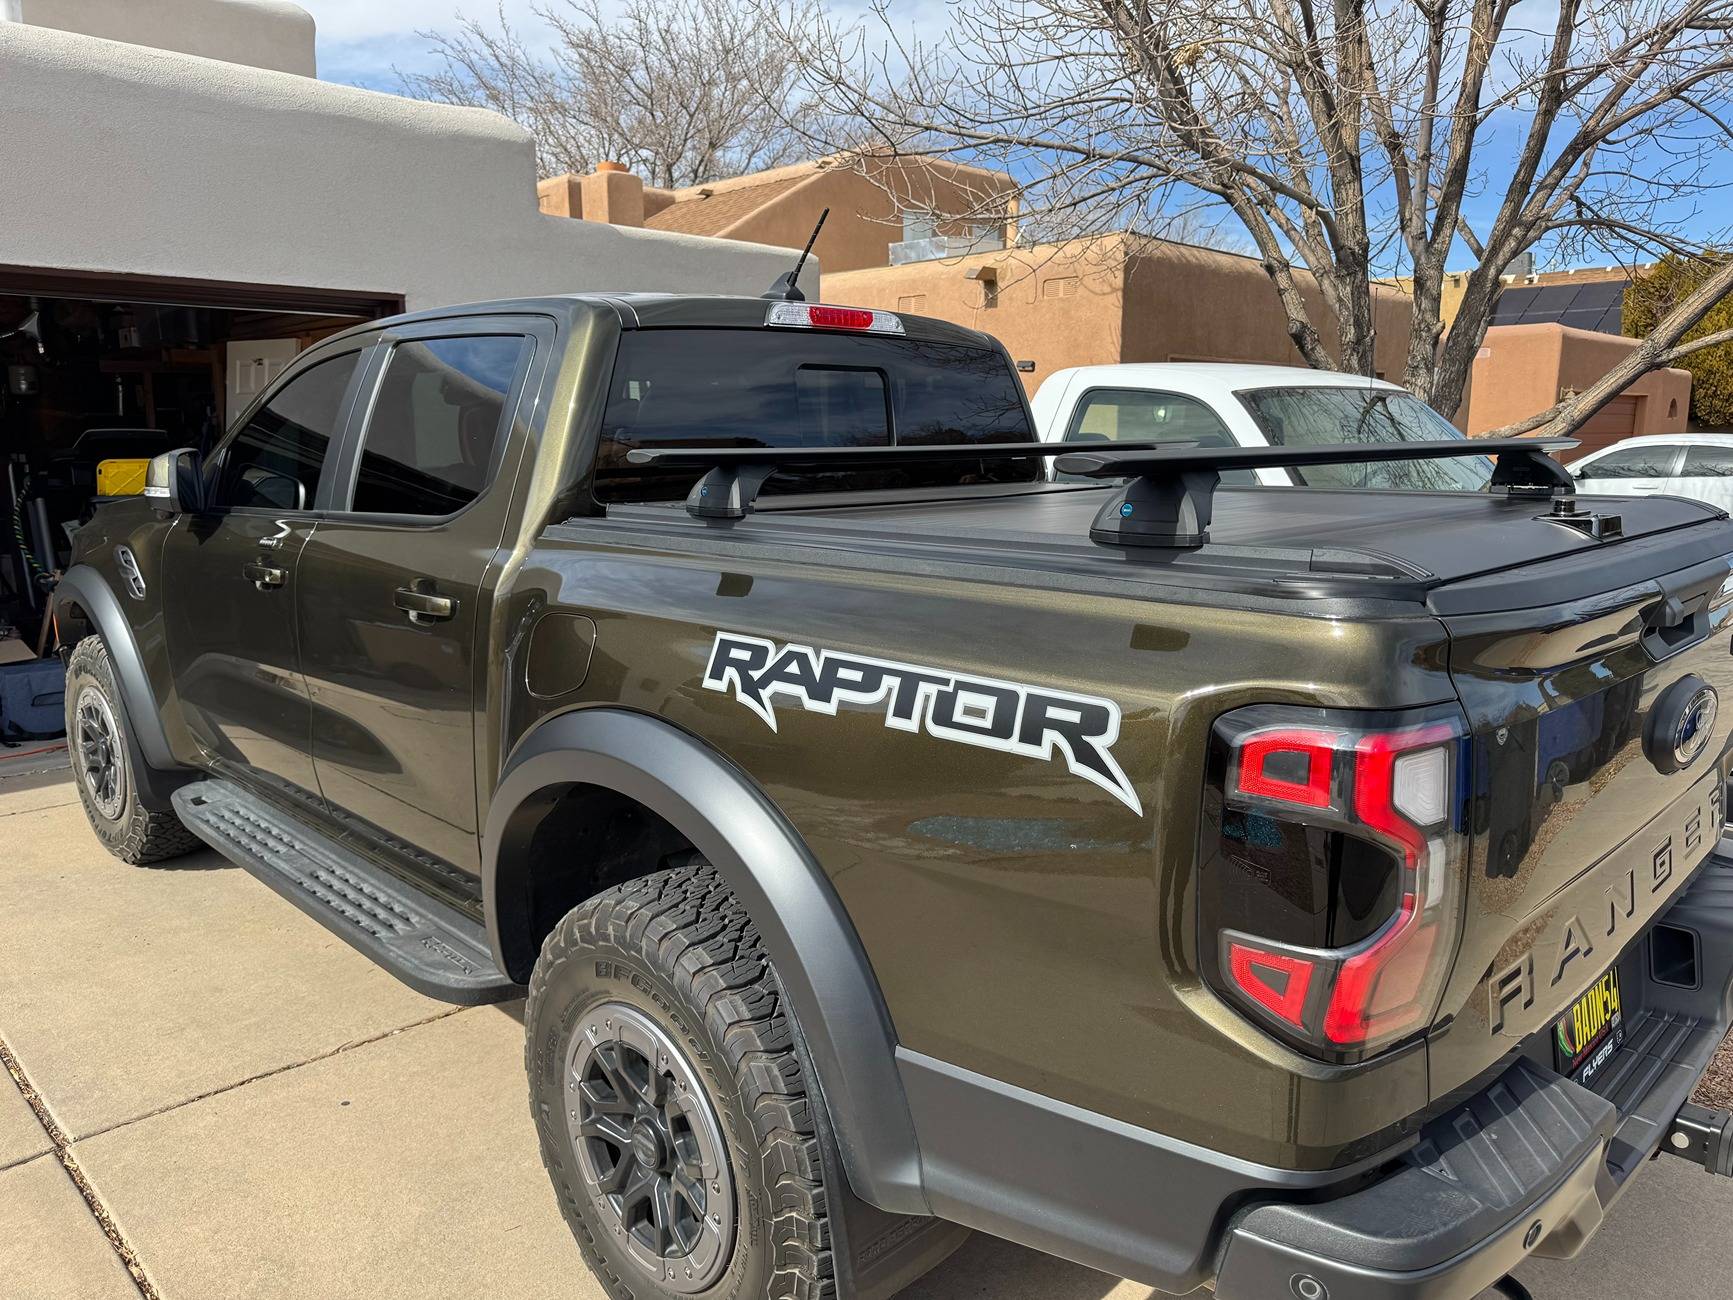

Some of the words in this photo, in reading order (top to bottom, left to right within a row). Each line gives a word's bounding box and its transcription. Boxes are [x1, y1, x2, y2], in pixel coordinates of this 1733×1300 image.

[701, 630, 1143, 818] RAPTOR
[1488, 781, 1722, 1036] RANGER
[1572, 966, 1620, 1055] BADN54
[1582, 1038, 1613, 1083] FLYERS
